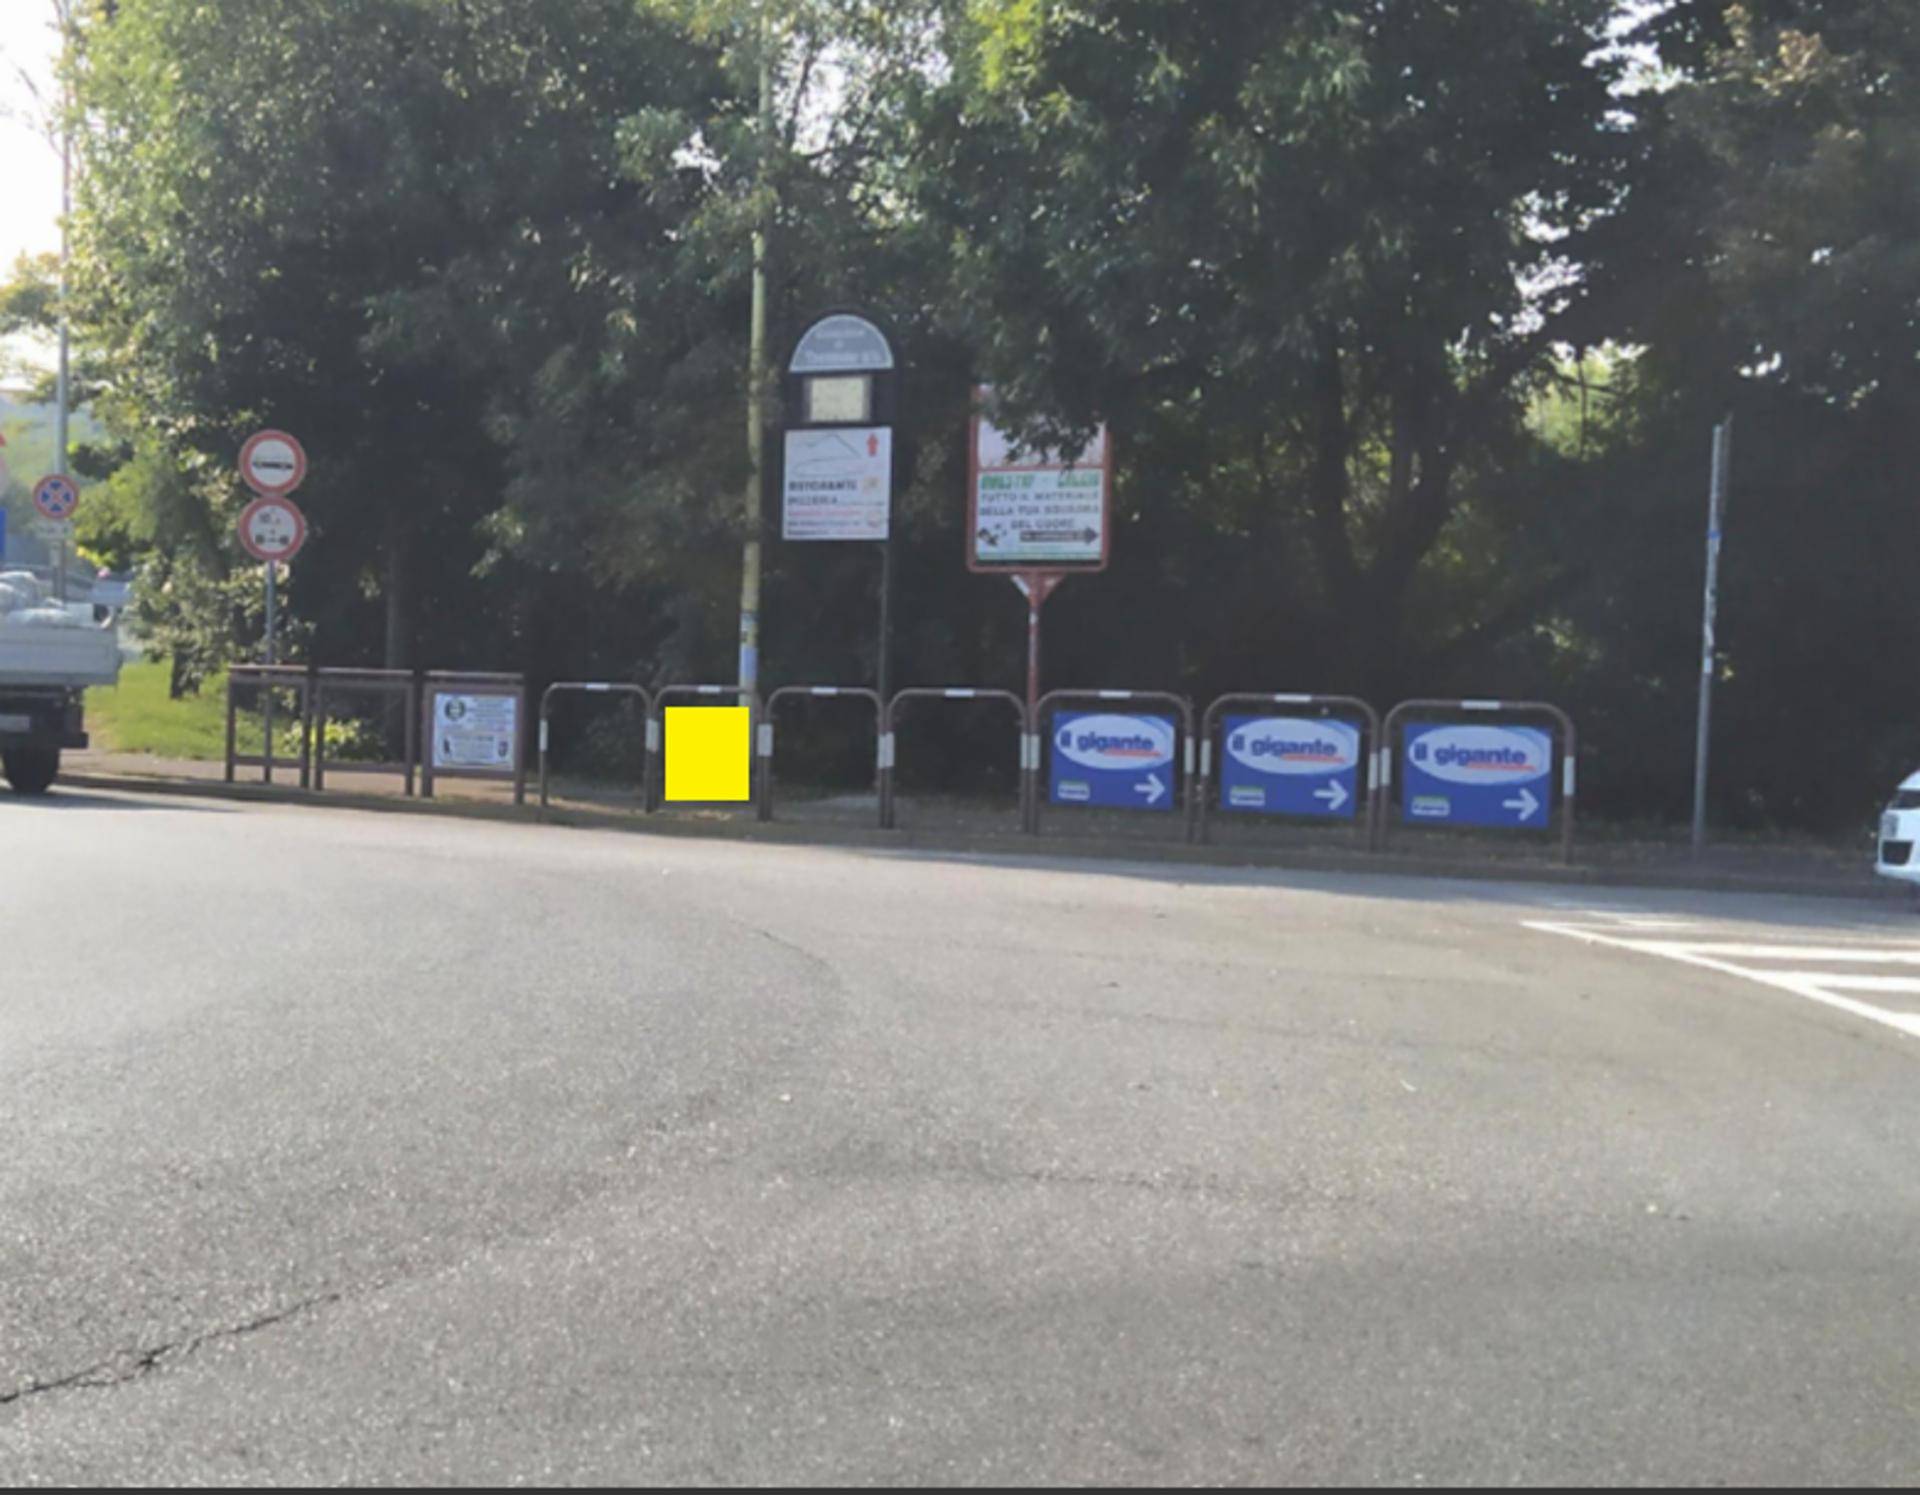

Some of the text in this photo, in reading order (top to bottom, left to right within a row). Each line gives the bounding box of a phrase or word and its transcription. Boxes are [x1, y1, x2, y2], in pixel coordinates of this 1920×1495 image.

[982, 493, 1017, 502] TUTTO
[980, 505, 1014, 515] DELLA
[1060, 730, 1154, 754] il gigante
[1232, 734, 1339, 757] il gigante
[1414, 742, 1528, 767] il gigante
